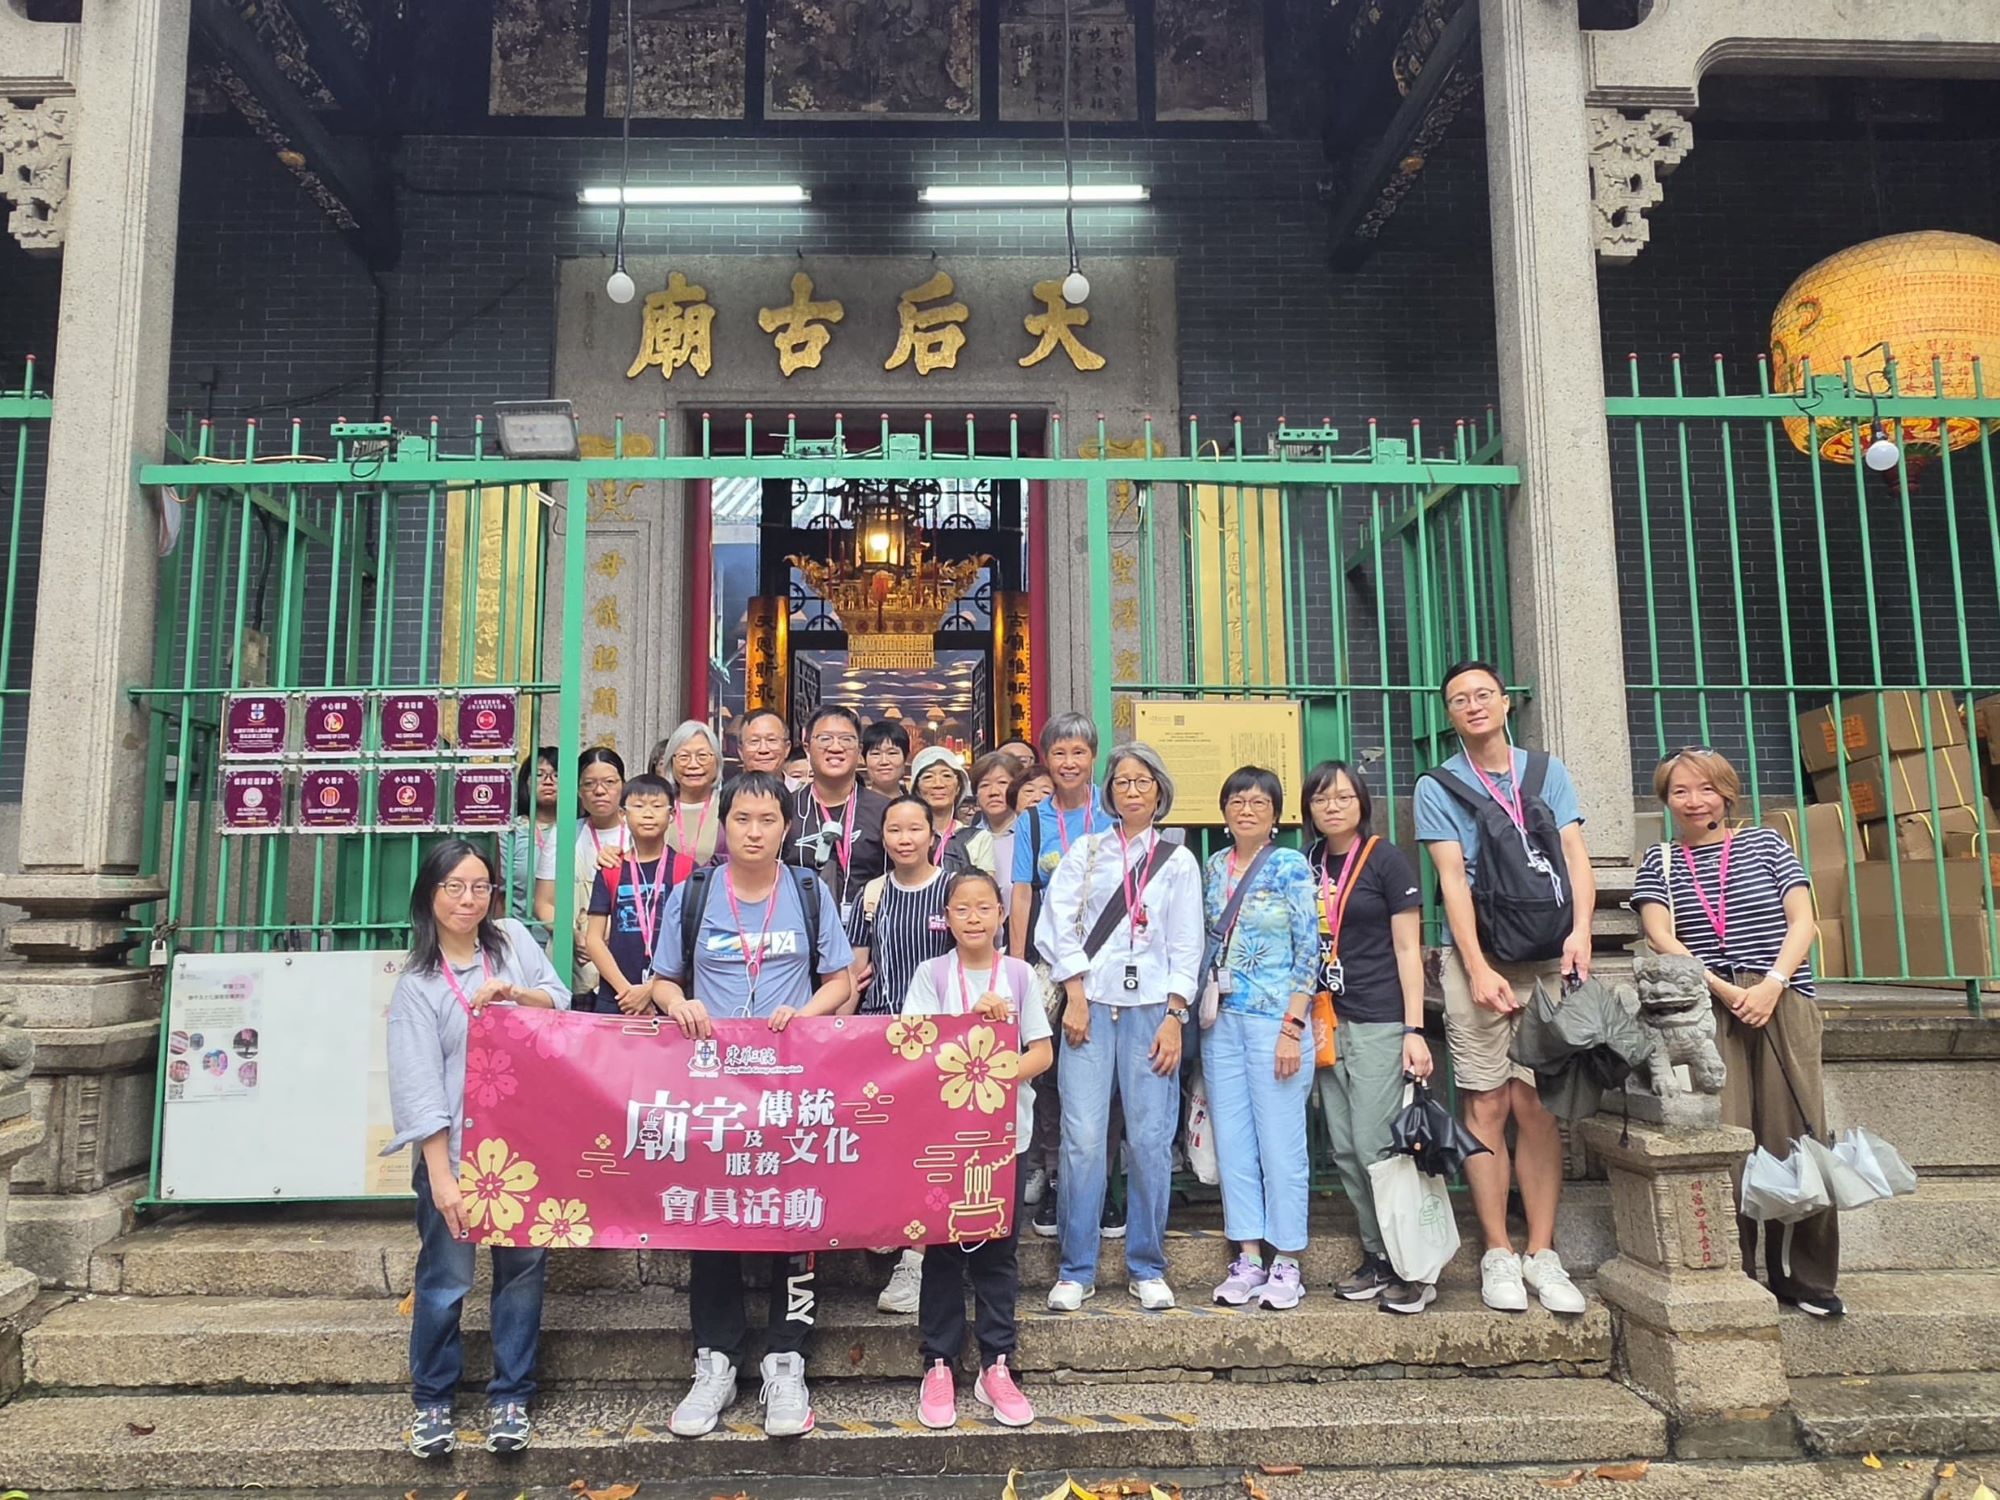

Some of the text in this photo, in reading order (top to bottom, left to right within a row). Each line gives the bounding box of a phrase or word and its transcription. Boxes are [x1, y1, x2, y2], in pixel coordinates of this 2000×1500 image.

[626, 271, 1107, 380] 天后古廟
[623, 1090, 748, 1163] 廟宇
[757, 1088, 836, 1128] 傳統
[743, 1129, 764, 1149] 及
[781, 1127, 861, 1165] 文化
[725, 1152, 782, 1176] 服務
[659, 1184, 826, 1229] 會員活動
